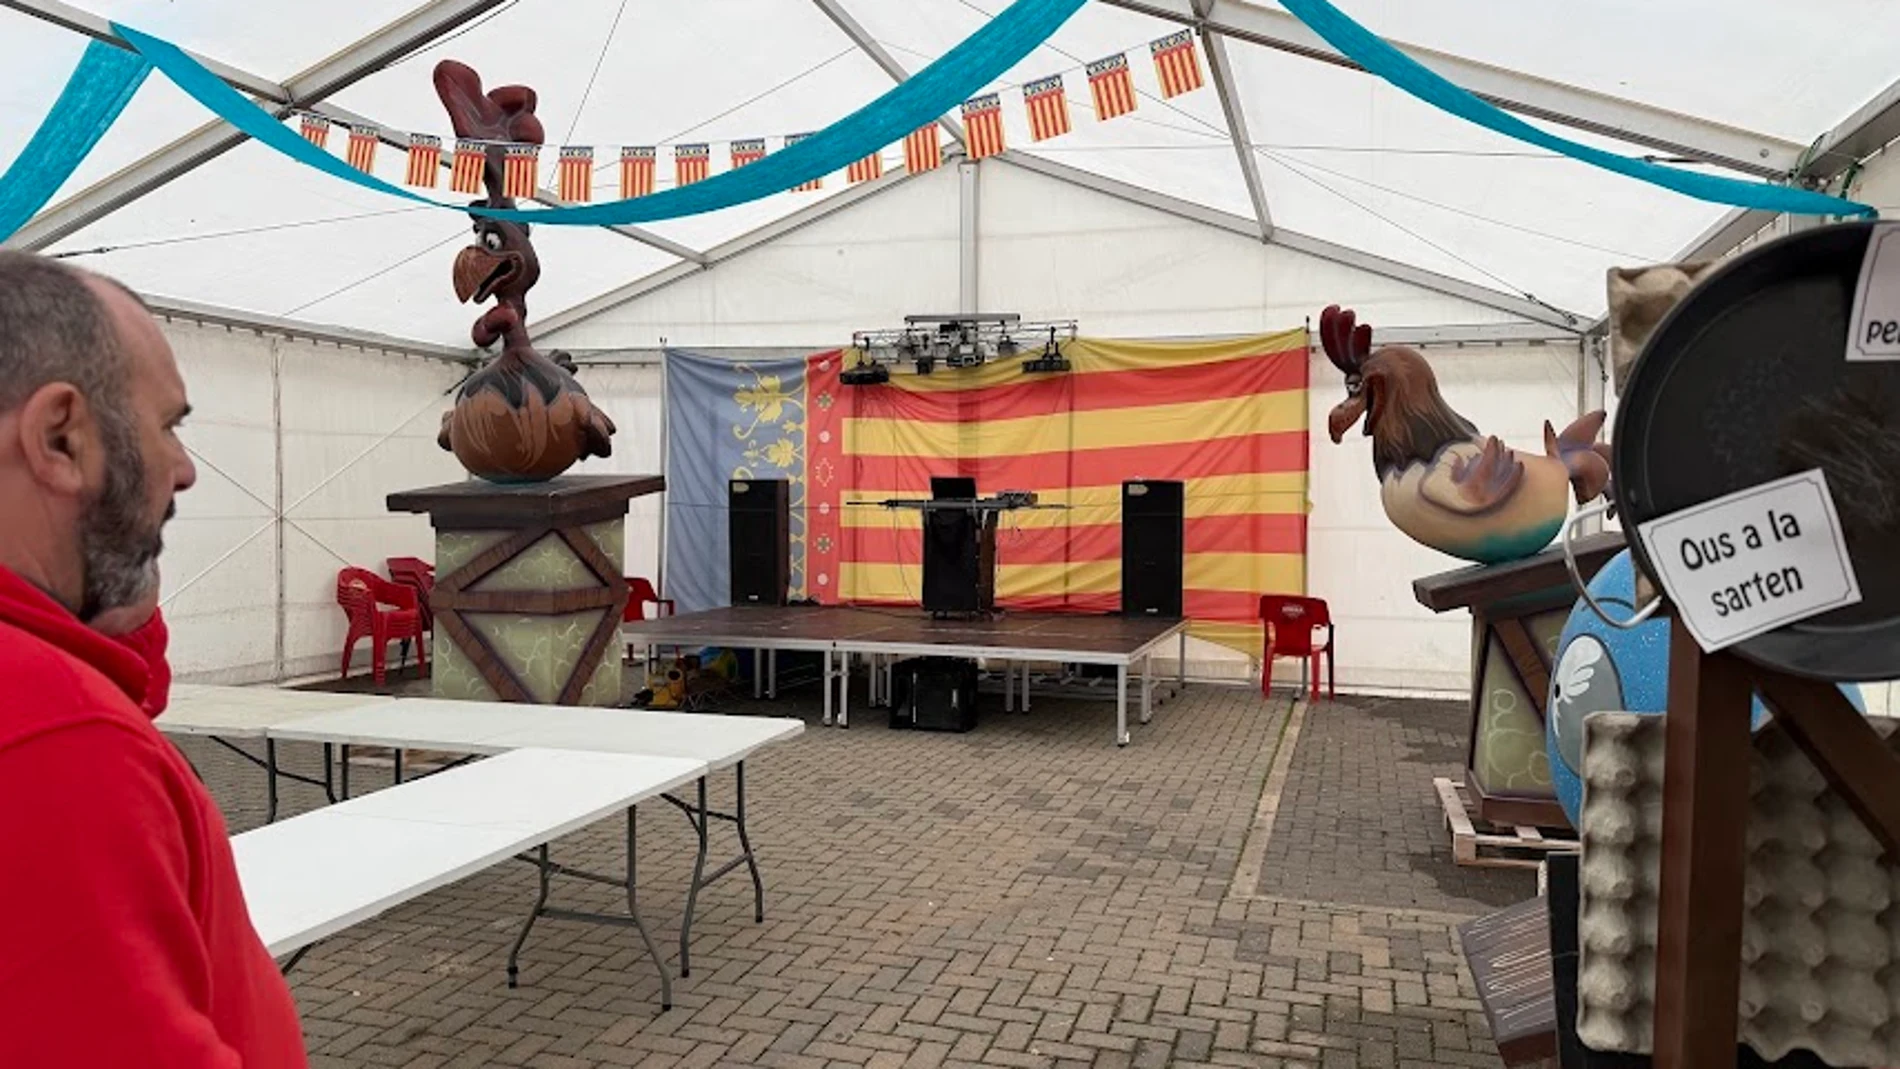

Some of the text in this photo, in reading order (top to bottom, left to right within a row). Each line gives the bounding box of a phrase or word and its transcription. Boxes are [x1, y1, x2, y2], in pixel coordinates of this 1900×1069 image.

[1866, 320, 1900, 344] pe
[1680, 509, 1801, 571] Ous a la
[1711, 566, 1803, 617] sarten
